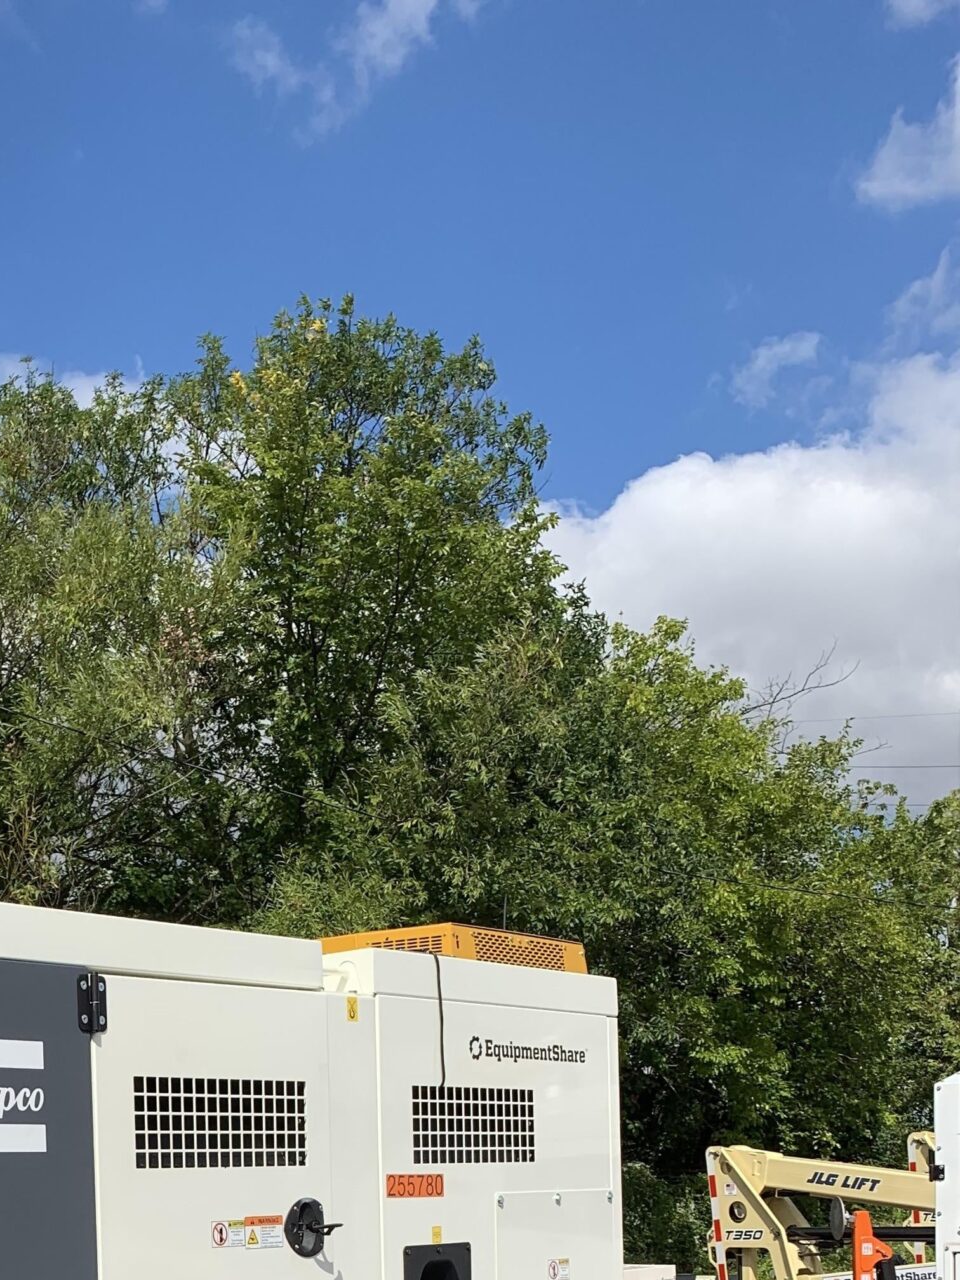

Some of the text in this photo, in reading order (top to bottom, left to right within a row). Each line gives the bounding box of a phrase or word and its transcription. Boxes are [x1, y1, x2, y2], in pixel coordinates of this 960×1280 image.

[484, 1039, 586, 1064] EquipmentShare
[387, 1174, 444, 1197] 255780
[806, 1171, 881, 1192] JLG LIFT
[725, 1230, 763, 1241] T350
